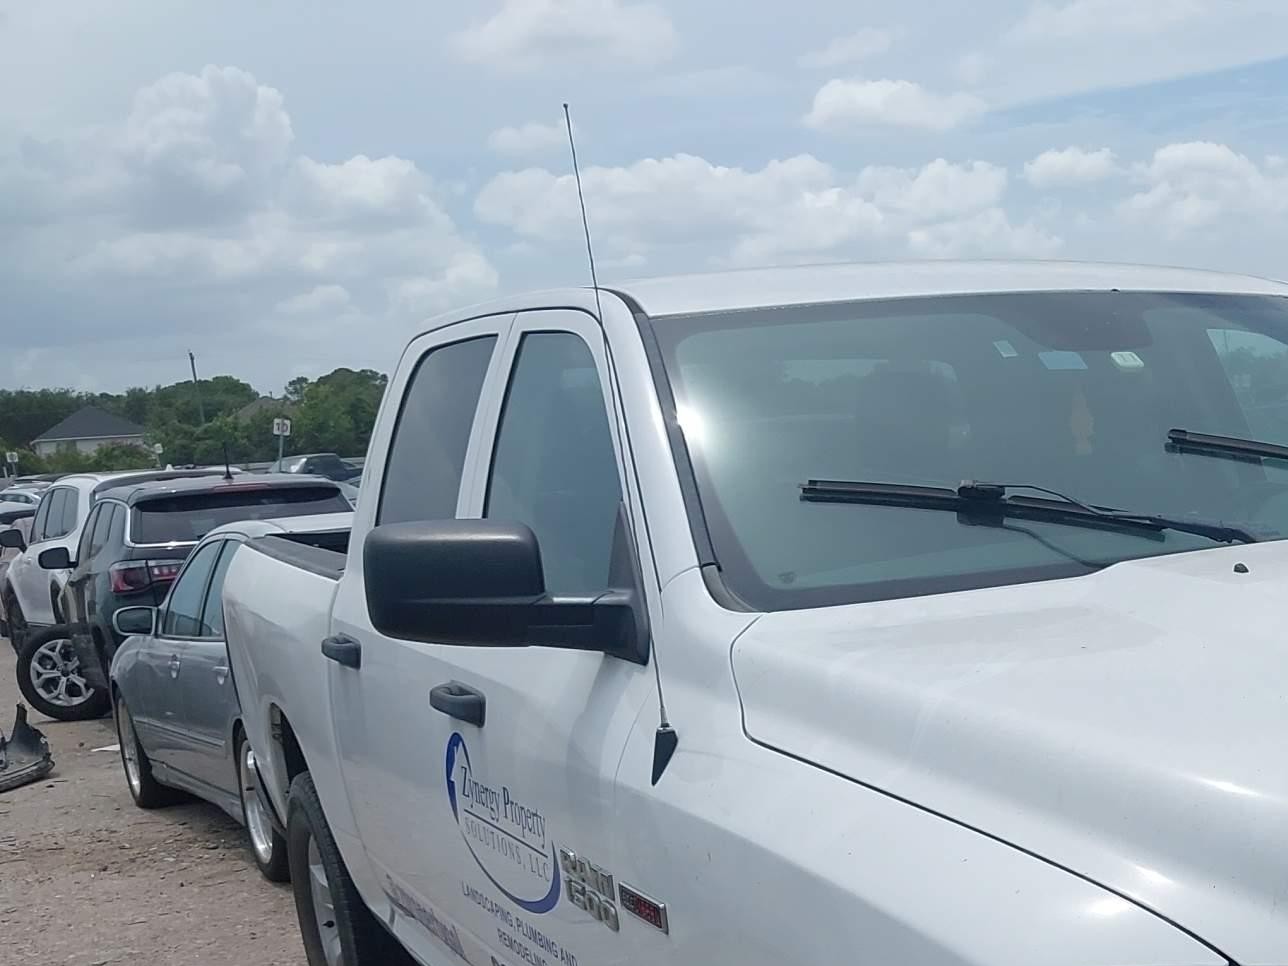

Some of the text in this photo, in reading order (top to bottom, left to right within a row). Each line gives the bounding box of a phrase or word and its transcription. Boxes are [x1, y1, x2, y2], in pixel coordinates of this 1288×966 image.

[461, 765, 547, 849] Zynergy Property
[528, 853, 550, 882] LLC
[565, 879, 620, 932] 1500
[516, 917, 559, 959] PLUMBING
